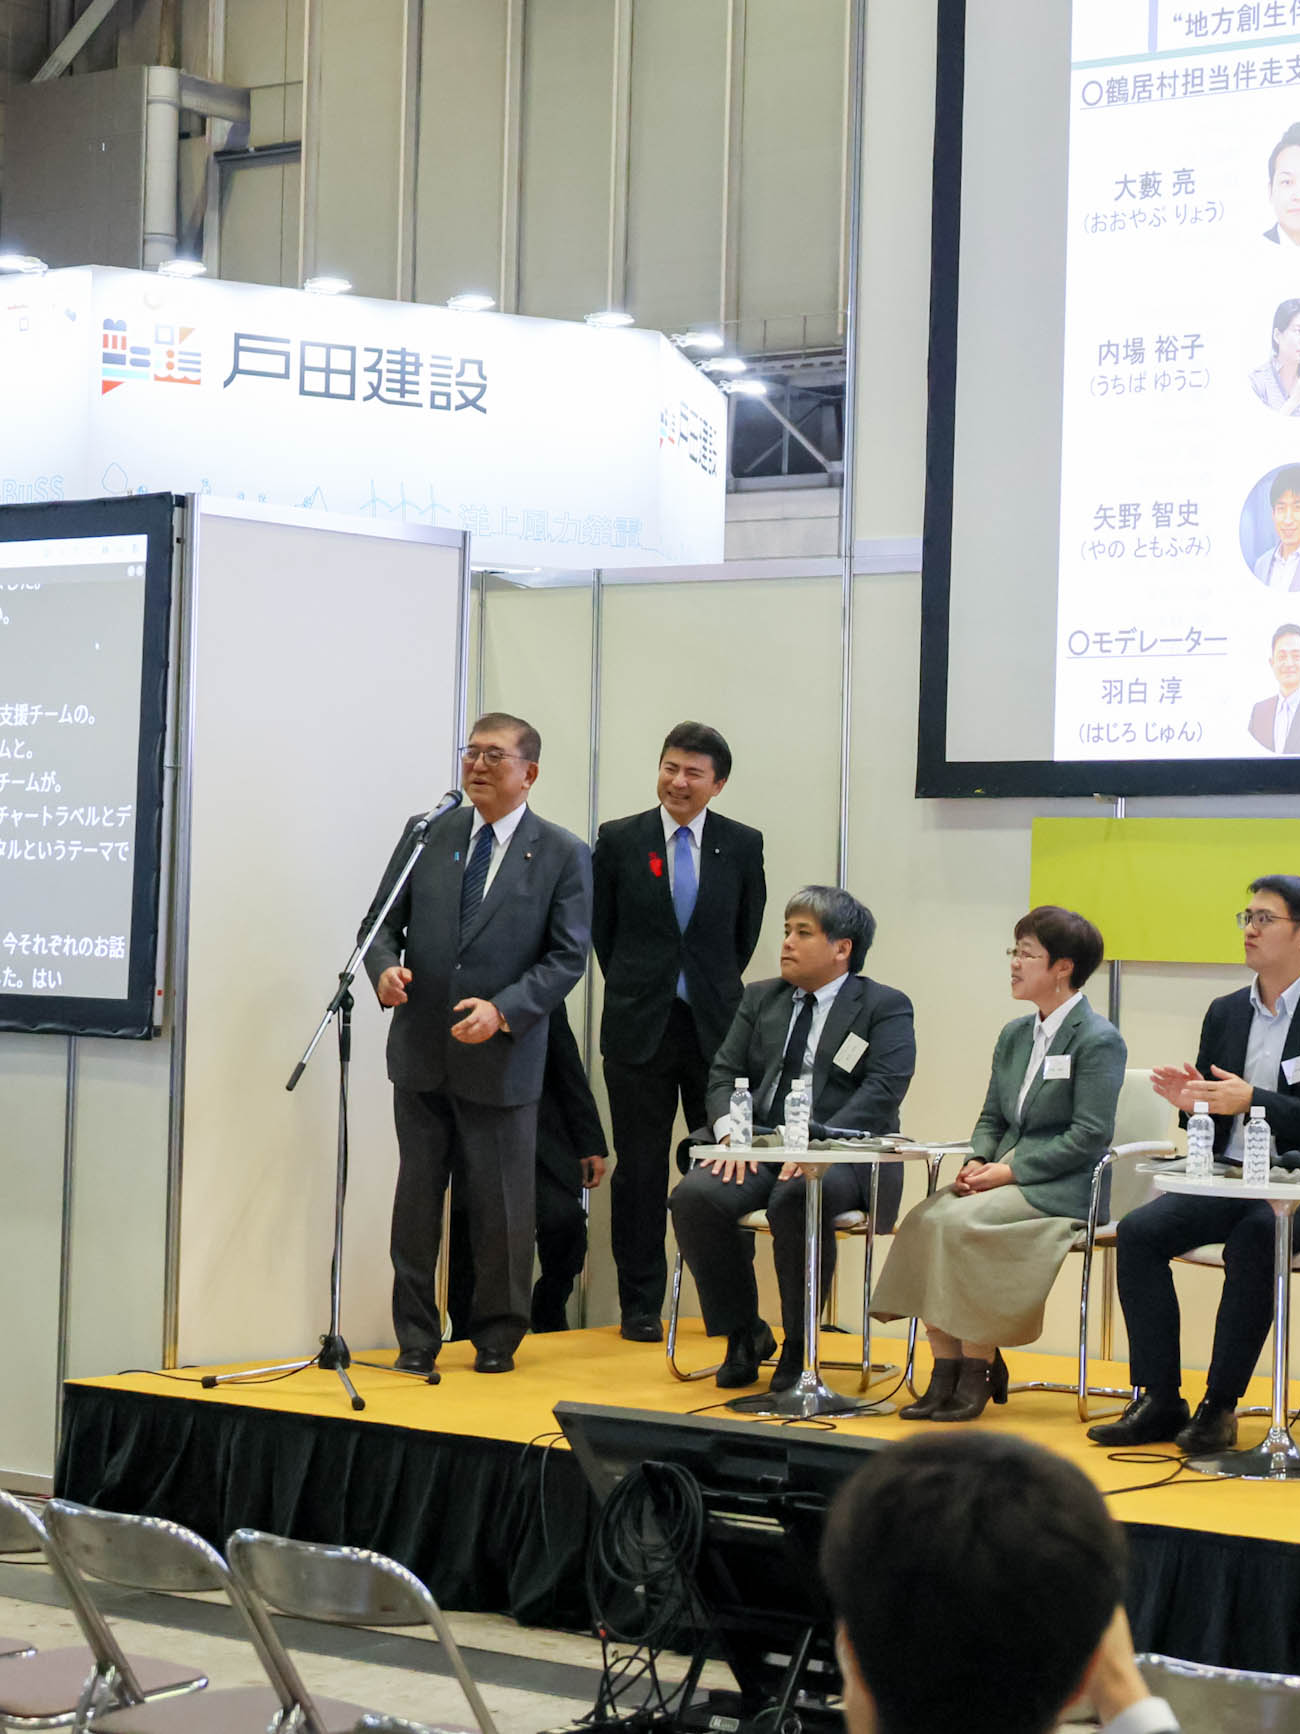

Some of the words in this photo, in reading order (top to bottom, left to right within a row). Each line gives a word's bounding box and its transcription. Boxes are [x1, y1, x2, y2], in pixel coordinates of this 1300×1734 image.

[1172, 168, 1195, 196] 亮
[1099, 337, 1145, 366] 内場
[1155, 334, 1204, 363] 裕子
[223, 332, 487, 414] 戸田建設
[1093, 503, 1142, 531] 矢野
[1152, 499, 1199, 528] 智史
[1101, 678, 1147, 704] 羽白
[1159, 676, 1182, 704] 淳
[2, 931, 125, 959] 今それぞれのお話
